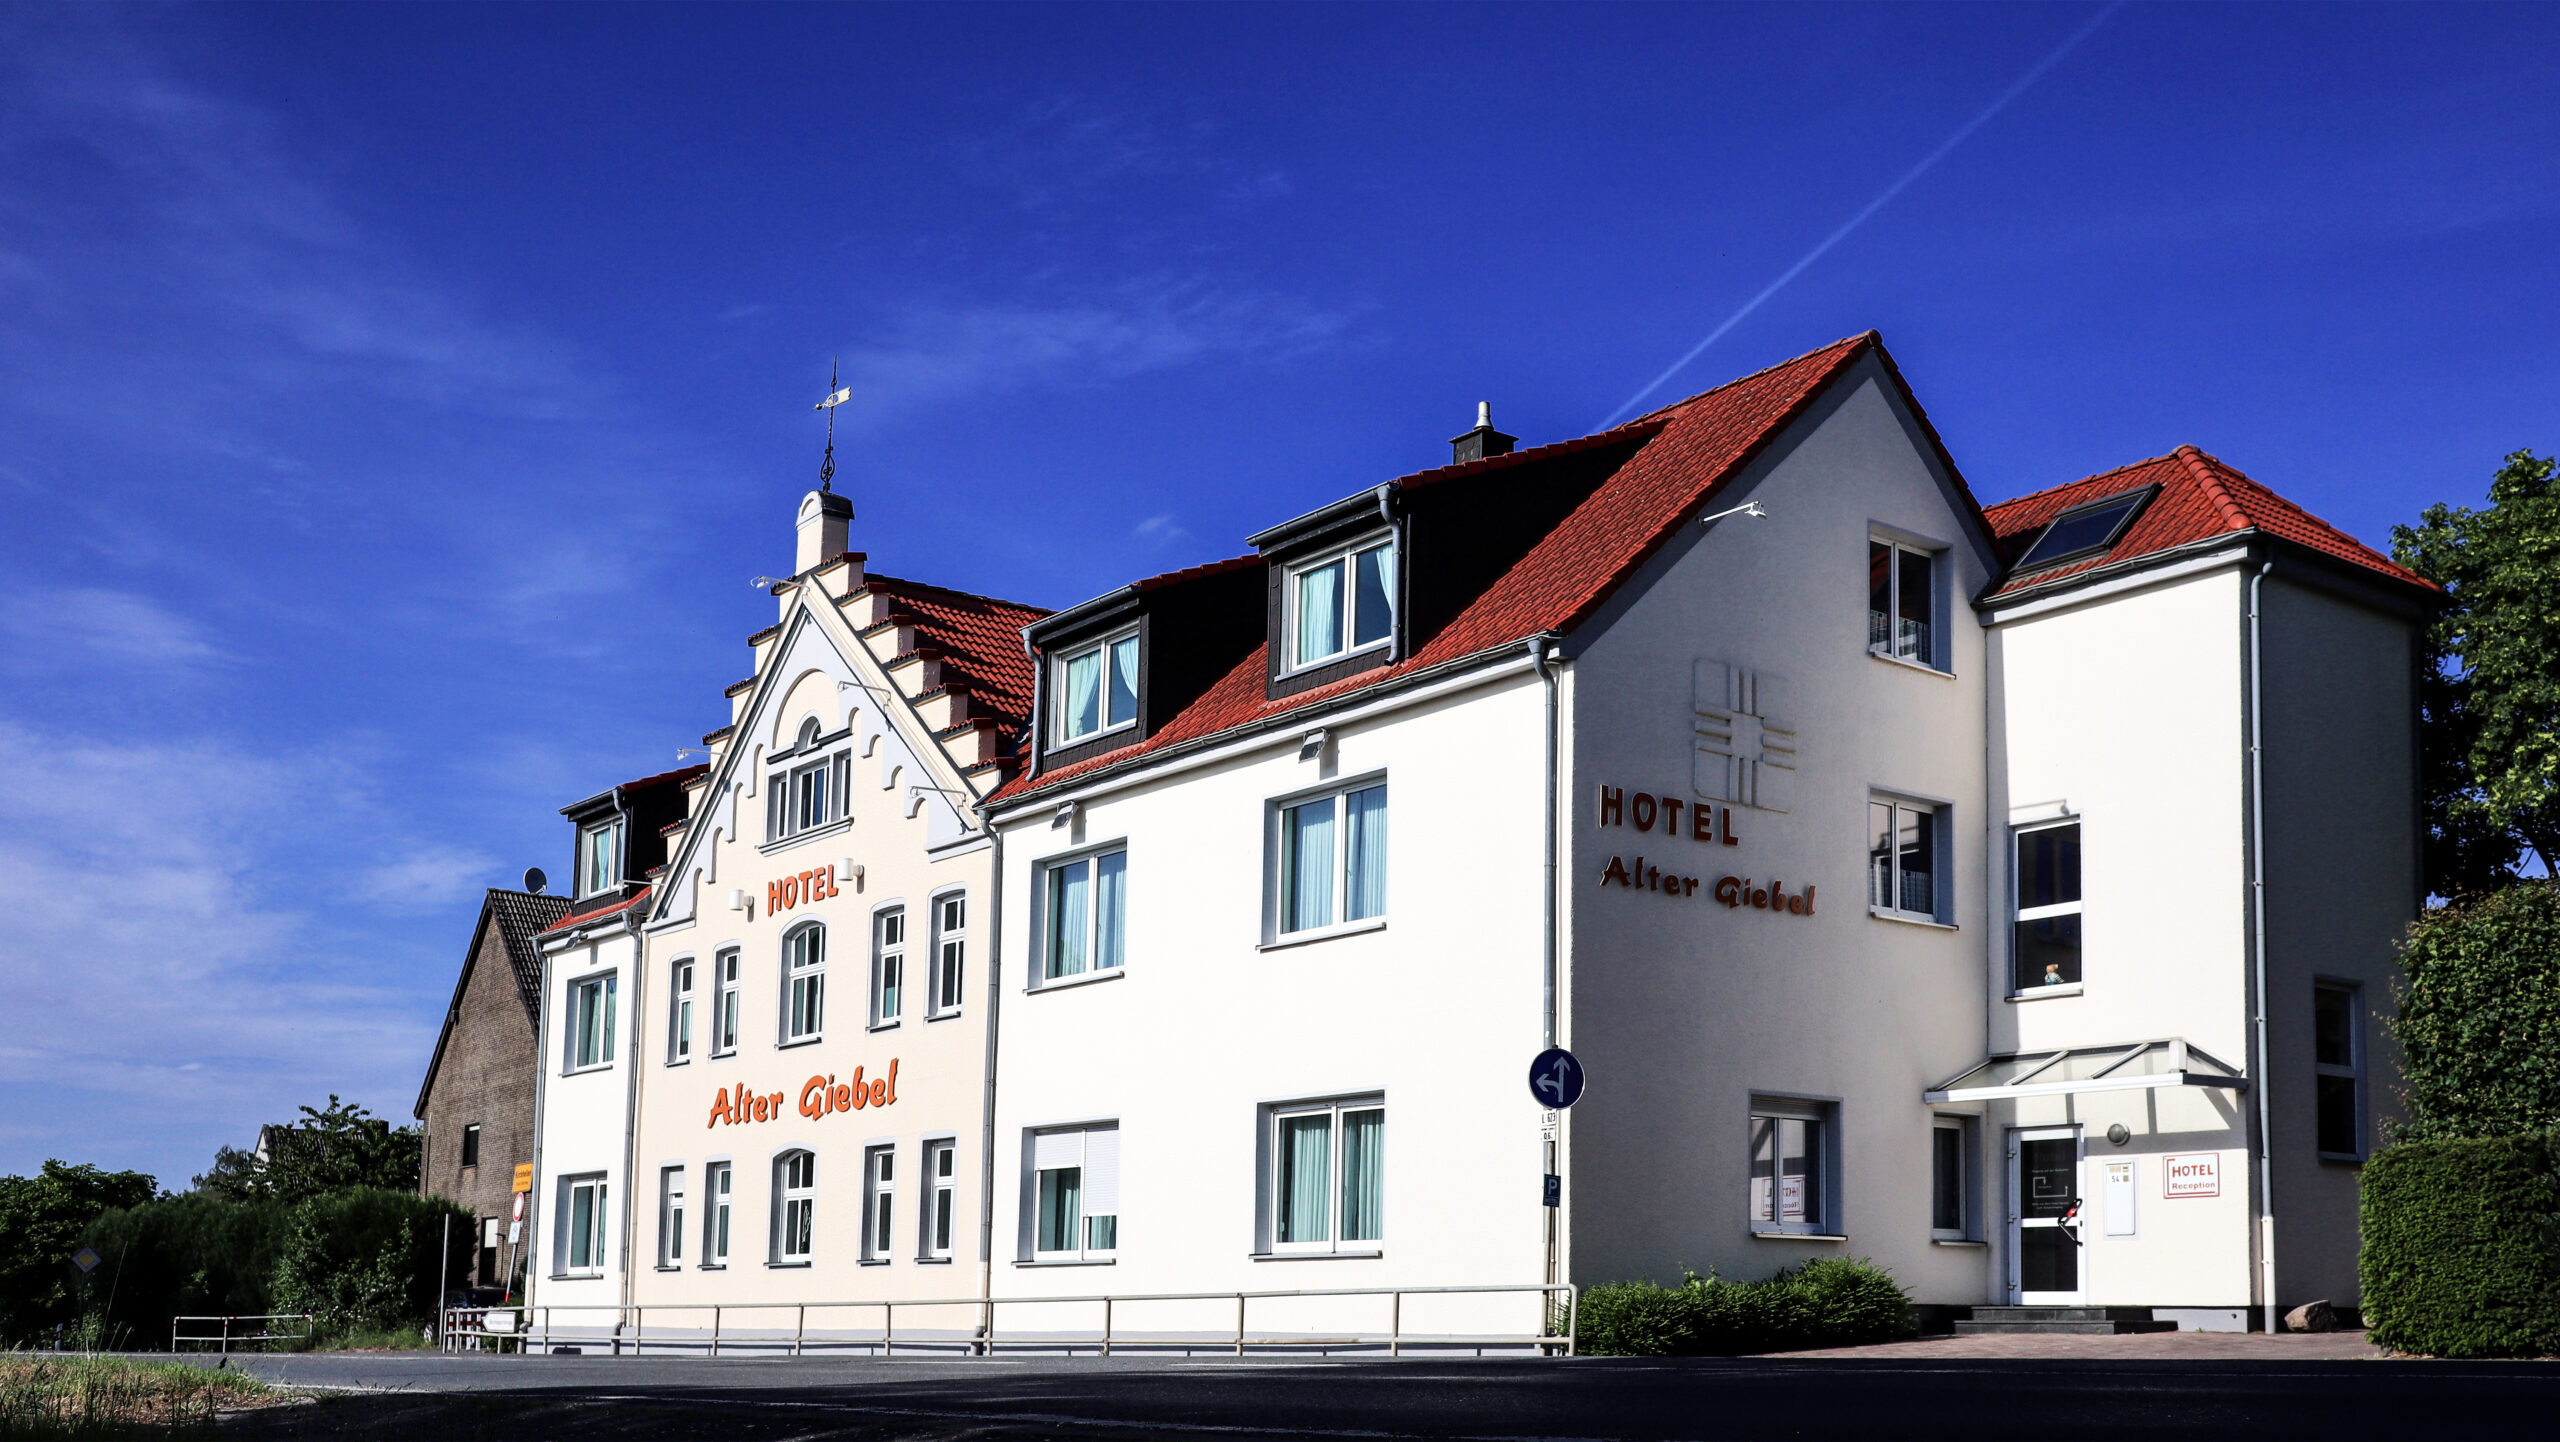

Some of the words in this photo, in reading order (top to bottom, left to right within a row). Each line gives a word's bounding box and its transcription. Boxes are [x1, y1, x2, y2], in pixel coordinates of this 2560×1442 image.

[1599, 783, 1740, 847] HOTEL
[767, 864, 840, 918] HOTEL
[1599, 855, 1700, 898] Alter
[1714, 876, 1817, 917] Giebel
[707, 1081, 784, 1130] Alter
[798, 1057, 900, 1122] Giebel
[1547, 1178, 1558, 1195] P
[2171, 1164, 2214, 1179] HOTEL
[2171, 1181, 2216, 1191] Reception
